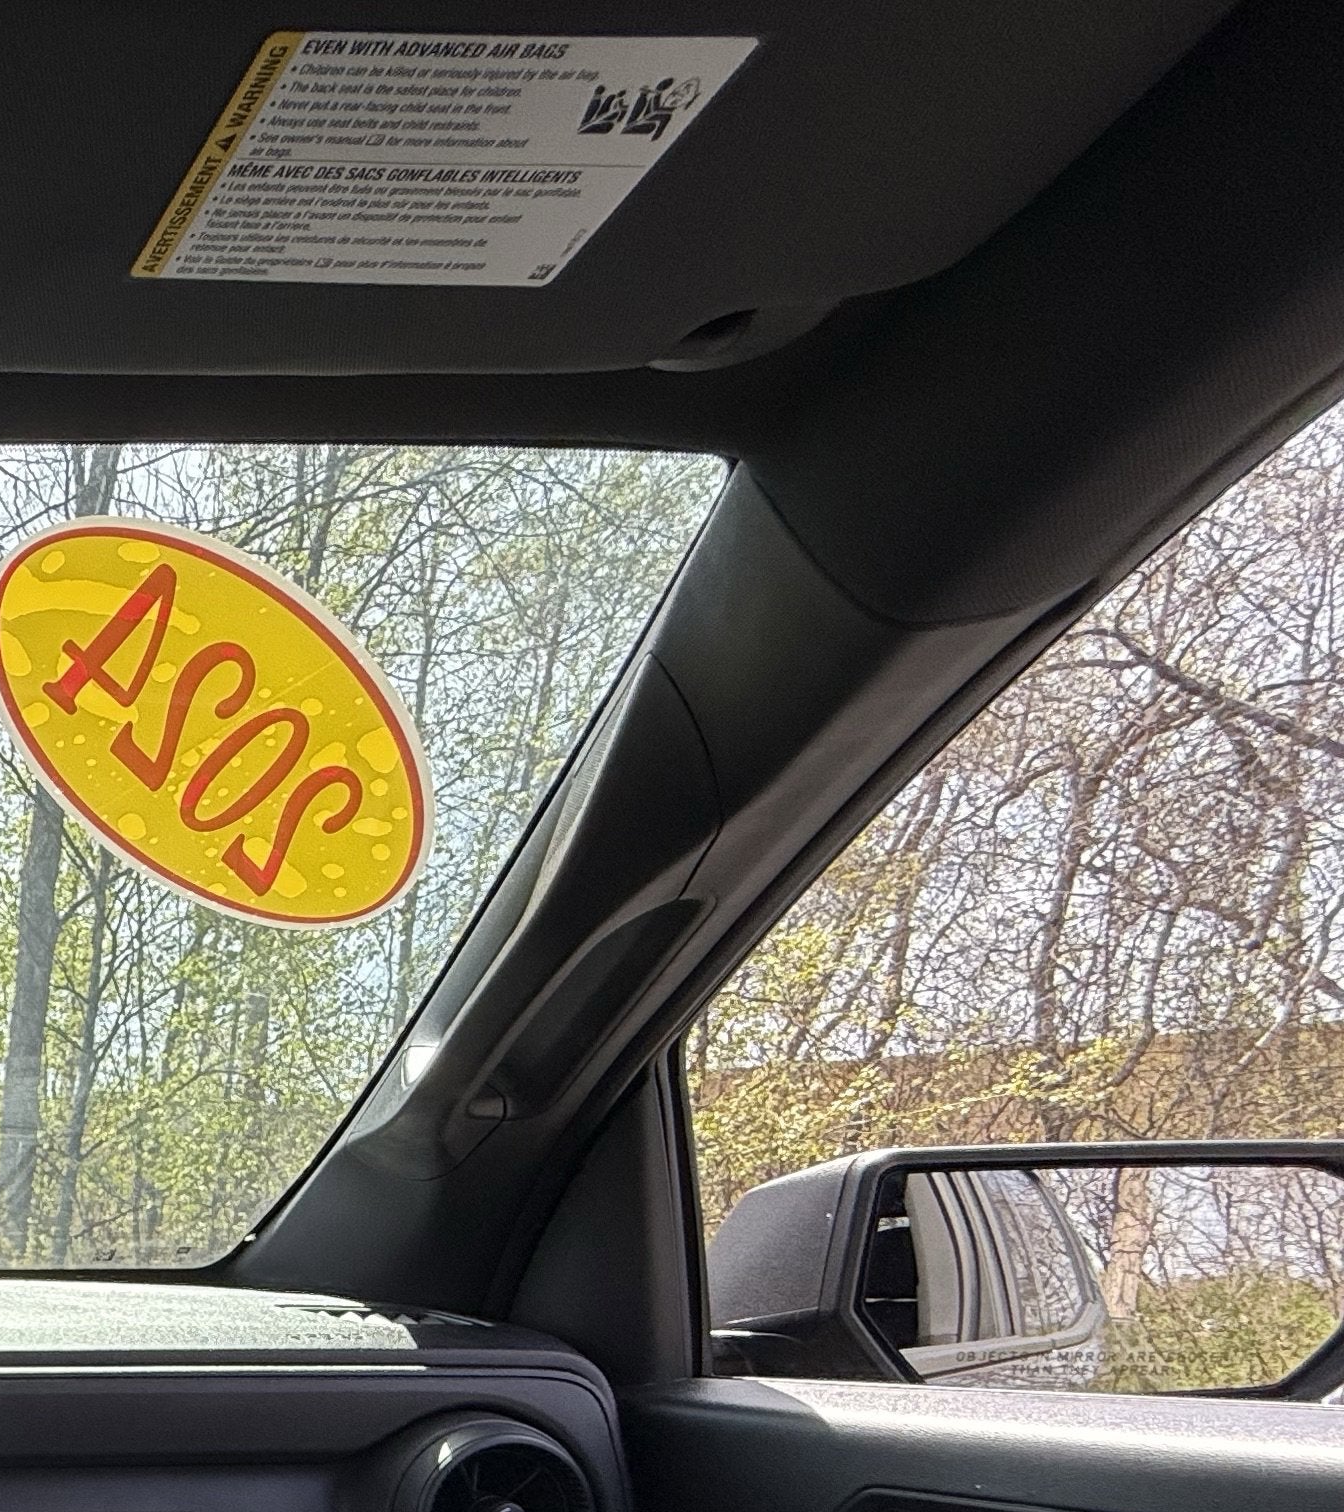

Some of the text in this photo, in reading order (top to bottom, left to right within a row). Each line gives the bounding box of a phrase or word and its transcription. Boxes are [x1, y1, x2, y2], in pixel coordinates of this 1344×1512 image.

[301, 39, 570, 59] EVEN WITH ADVANCED AIR BAGS
[298, 63, 600, 81] Children can be killed or seriously injured by the air bag.
[225, 45, 288, 129] WARNING
[289, 81, 523, 97] The back seat is the safest place for children.
[277, 100, 512, 114] Never put a rear-facing child seat in the front.
[257, 132, 529, 148] See owner's manual for more information about
[227, 163, 585, 184] MÊME AVEC DES SACS GONFLABLES INTELLIGENTS
[141, 157, 223, 272] AVERTISSEMENT
[1057, 1351, 1117, 1363] MIRROR
[1126, 1352, 1156, 1363] ARE
[1012, 1364, 1055, 1376] THAN
